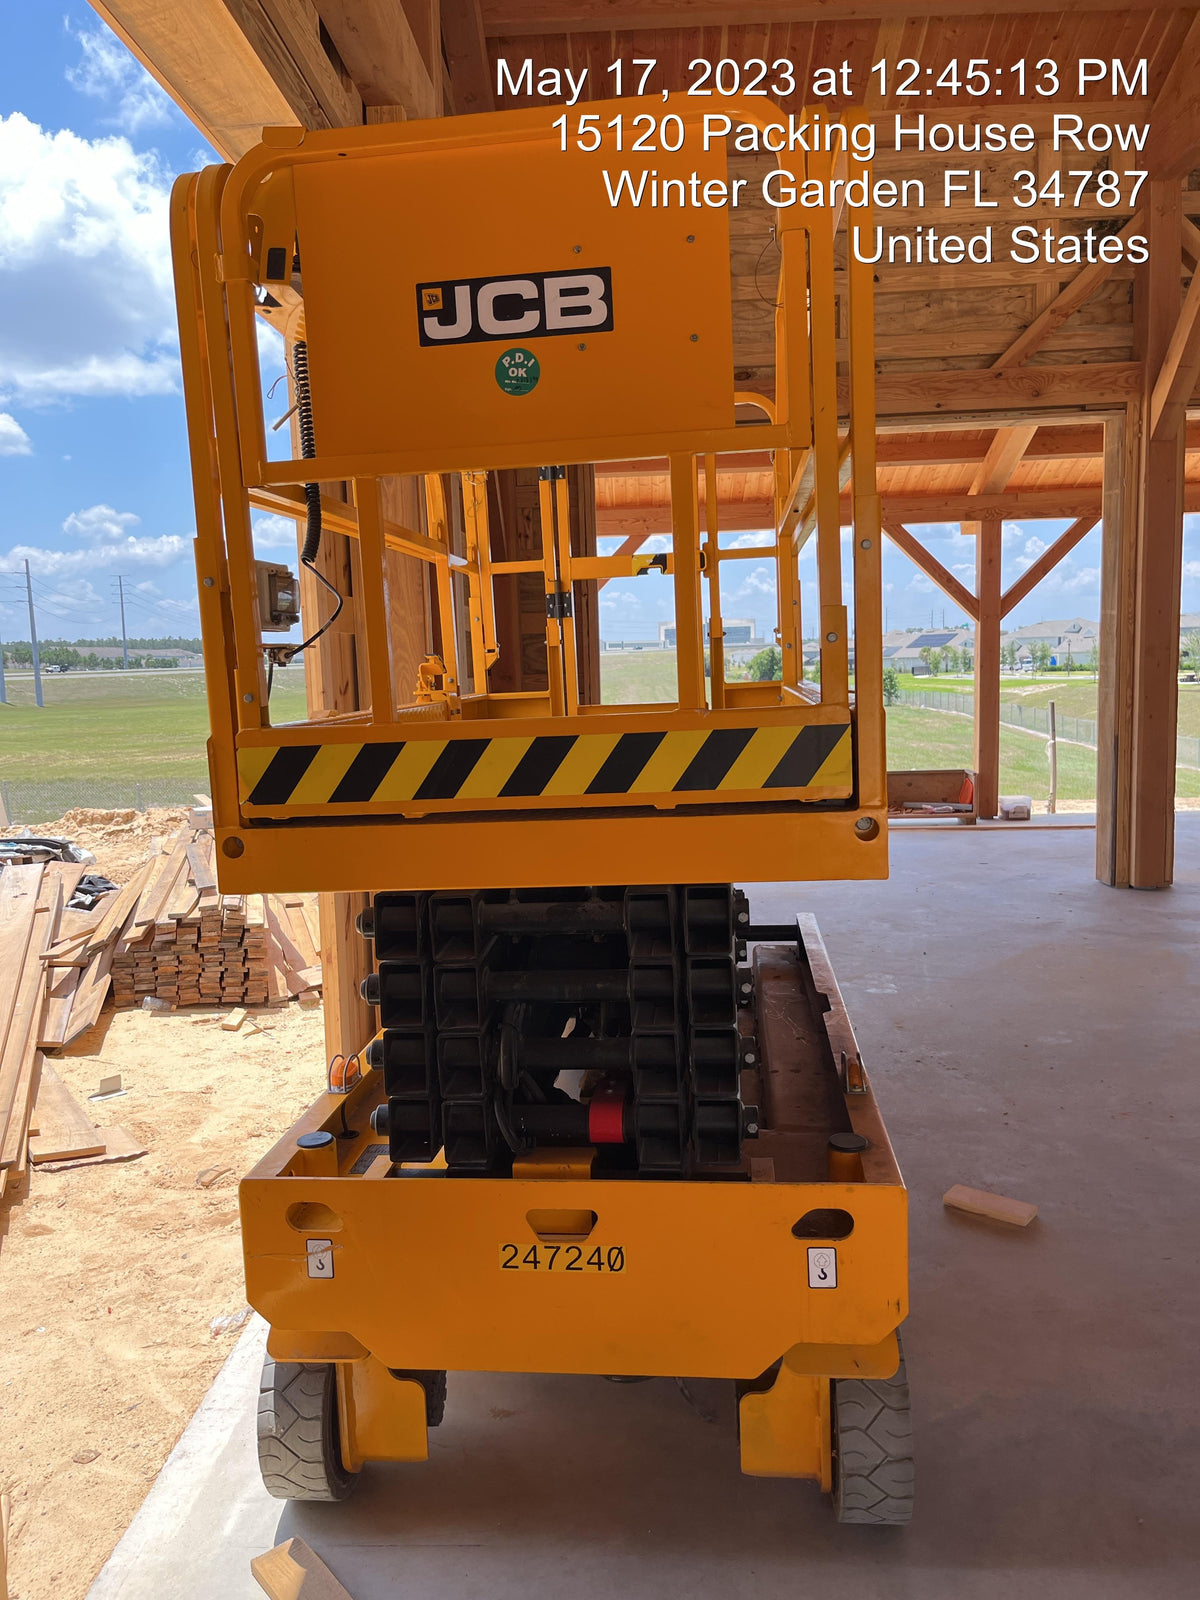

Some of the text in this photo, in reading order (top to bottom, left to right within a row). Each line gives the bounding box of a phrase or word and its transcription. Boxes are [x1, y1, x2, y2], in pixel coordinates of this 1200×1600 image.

[424, 274, 608, 340] JCB
[508, 367, 527, 377] OK
[501, 1243, 625, 1273] 247240
